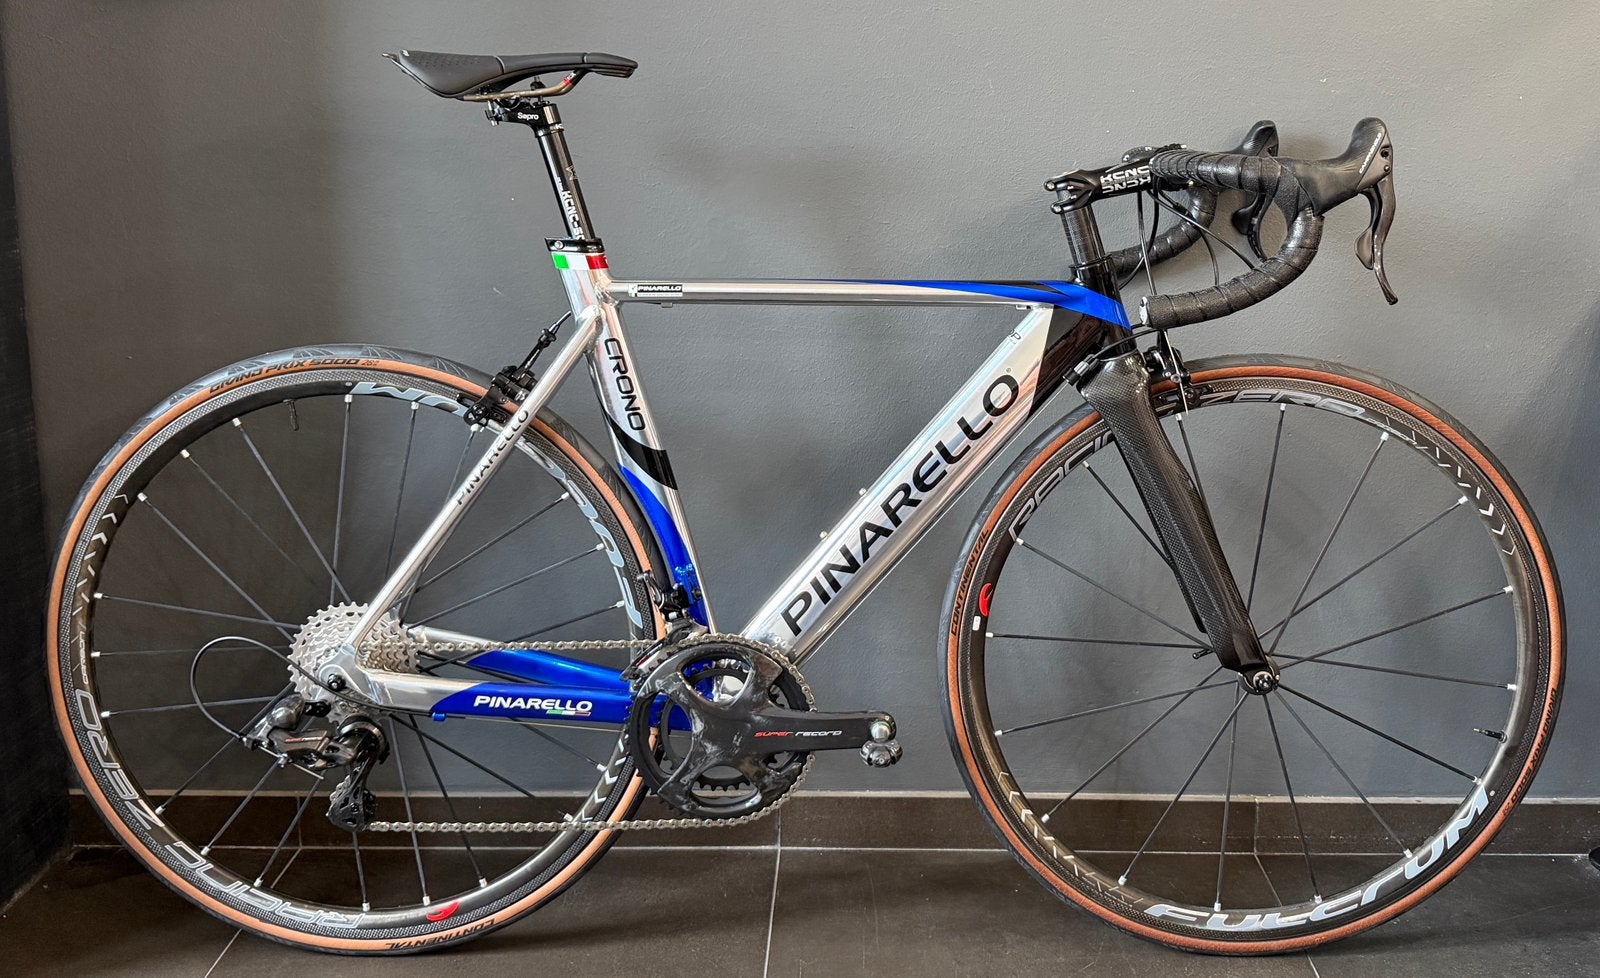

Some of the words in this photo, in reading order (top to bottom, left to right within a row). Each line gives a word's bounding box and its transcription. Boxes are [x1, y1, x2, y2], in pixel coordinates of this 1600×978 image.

[1100, 165, 1150, 184] KCNC
[604, 337, 646, 431] CRONO
[781, 374, 1019, 637] PINARELLO
[950, 527, 990, 637] CONTINENTAL
[473, 694, 593, 712] PINARELLO
[1143, 784, 1490, 932] FULCRUM
[385, 918, 496, 950] CONTINENTAL
